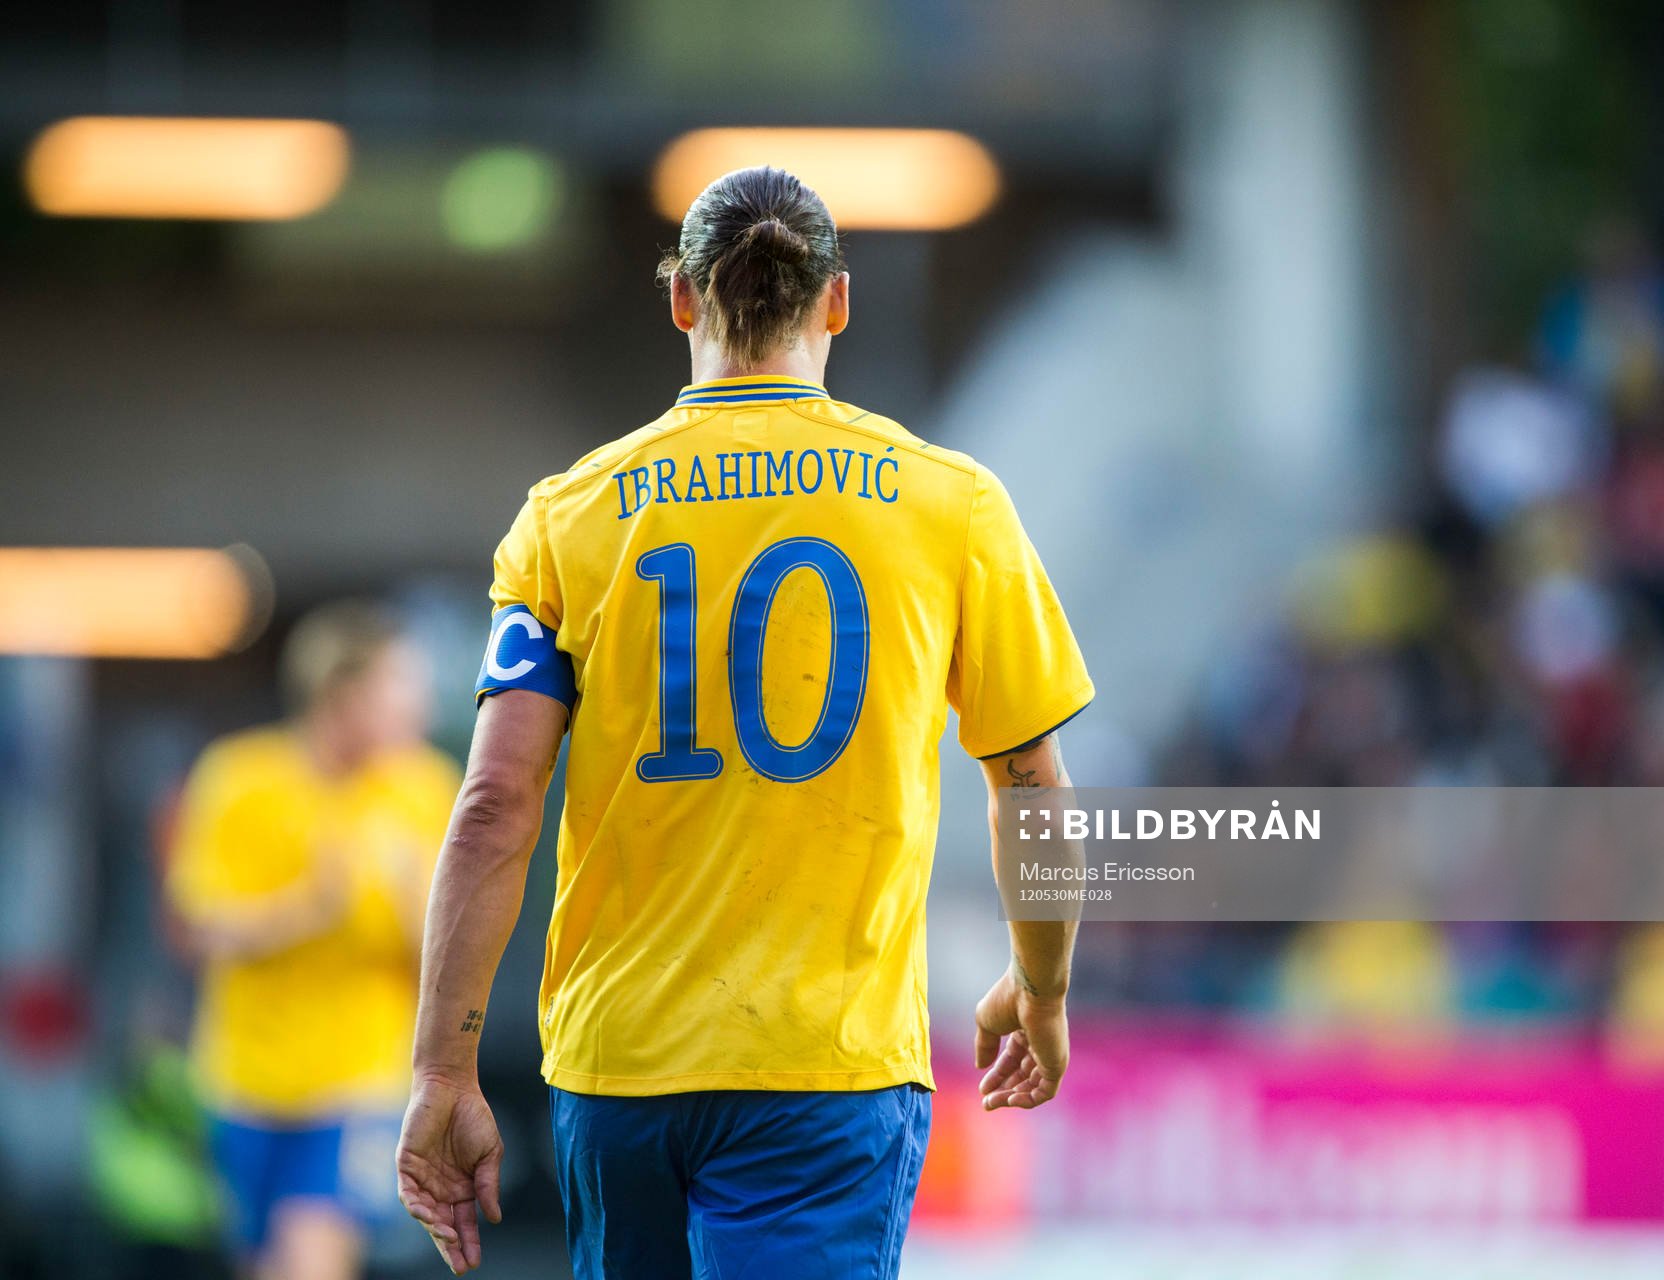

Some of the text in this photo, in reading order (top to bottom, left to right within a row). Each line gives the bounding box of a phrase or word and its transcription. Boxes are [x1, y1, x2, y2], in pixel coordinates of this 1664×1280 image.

[612, 446, 899, 520] IBRAHIMOVIĆ
[487, 612, 544, 681] C
[635, 536, 870, 784] 10
